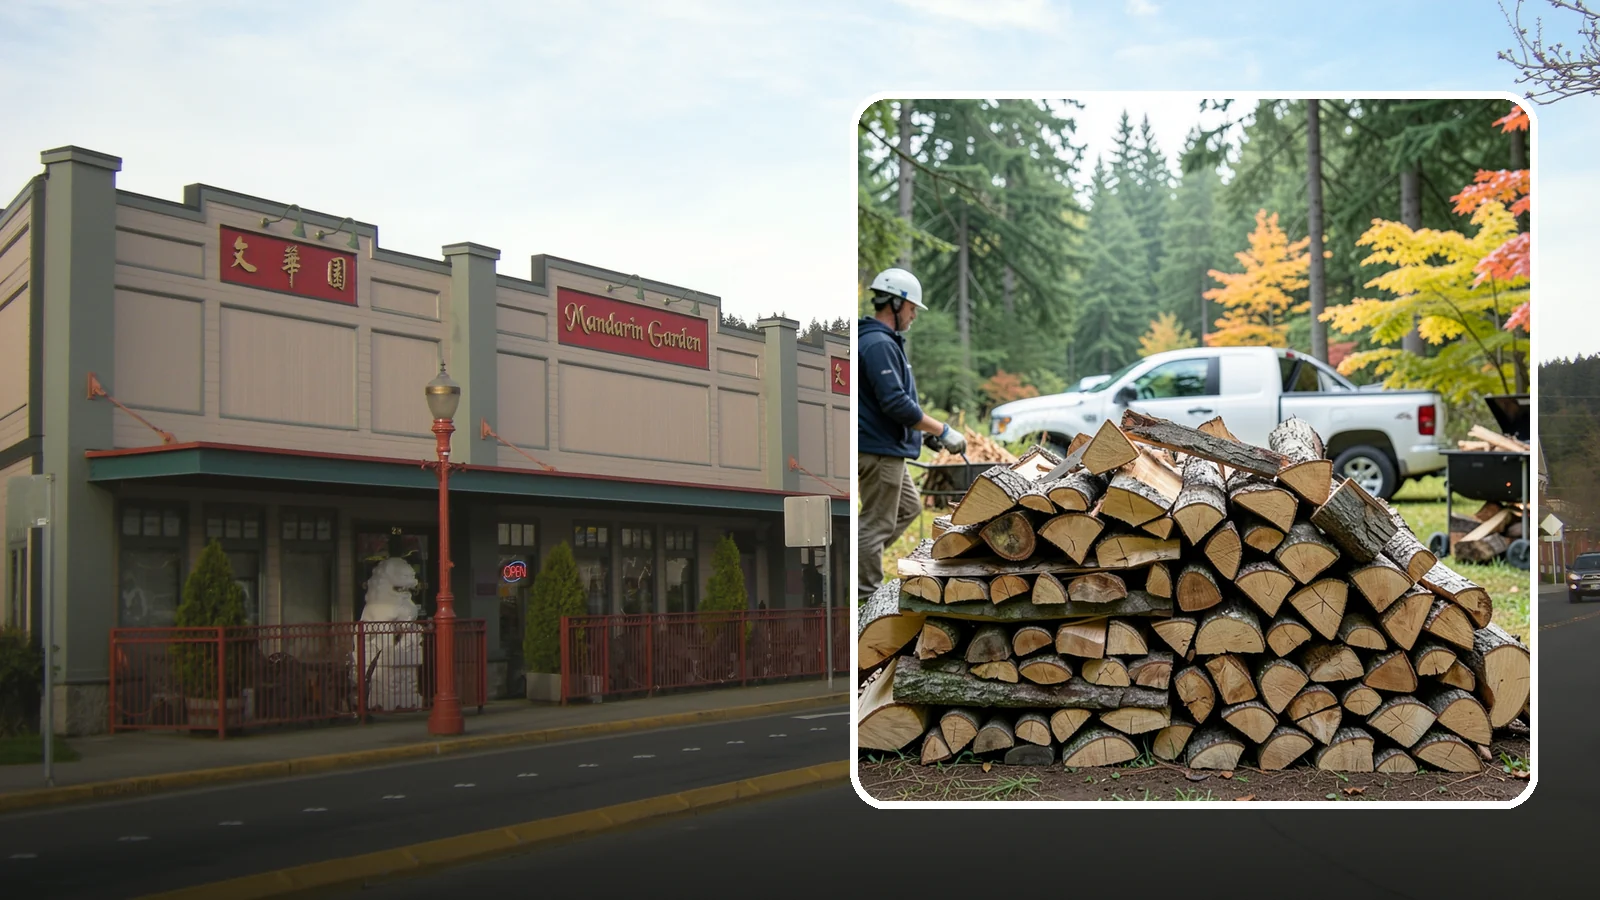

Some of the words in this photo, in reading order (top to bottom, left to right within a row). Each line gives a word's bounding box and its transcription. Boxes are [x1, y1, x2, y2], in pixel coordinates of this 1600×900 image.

[231, 236, 346, 290] 文華園
[565, 303, 643, 340] Mandarin
[648, 321, 701, 351] Garden
[835, 363, 846, 386] 文
[504, 565, 527, 578] OPEN
